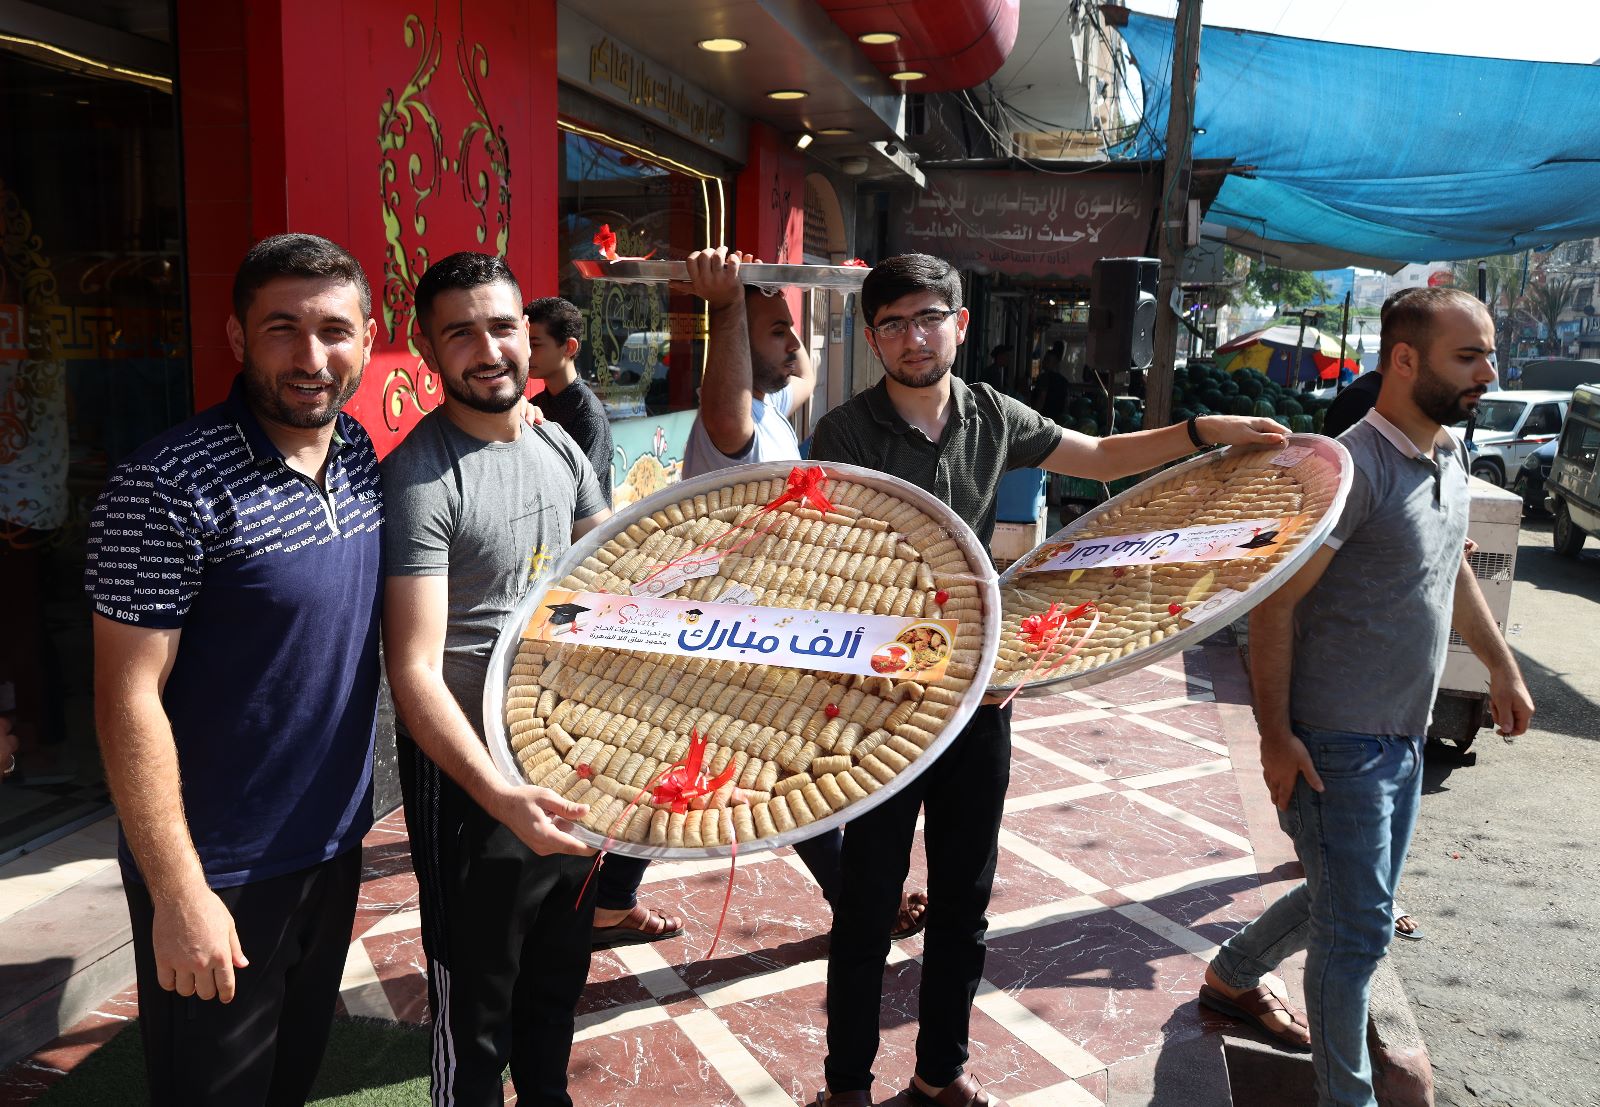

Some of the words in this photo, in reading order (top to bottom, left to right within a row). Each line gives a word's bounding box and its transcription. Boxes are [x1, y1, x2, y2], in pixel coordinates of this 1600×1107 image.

[206, 440, 223, 449] HUGO
[182, 452, 199, 464] HUGO
[212, 453, 230, 462] HUGO
[142, 465, 159, 473] BOSS
[161, 457, 178, 471] BOSS
[219, 466, 236, 476] HUGO
[243, 470, 260, 482] BOSS
[136, 480, 153, 488] BOSS
[157, 476, 178, 487] HUGO
[249, 485, 266, 497] BOSS
[358, 490, 376, 501] BOSS
[153, 491, 171, 502] HUGO
[173, 499, 192, 507] BOSS
[273, 500, 288, 511] HUGO
[288, 492, 304, 502] BOSS
[240, 506, 256, 516] HUGO
[256, 500, 271, 510] BOSS
[168, 511, 187, 523] BOSS
[278, 513, 295, 523] HUGO
[243, 522, 260, 532] HUGO
[261, 515, 275, 525] BOSS
[245, 535, 264, 545] HUGO
[265, 527, 282, 537] BOSS
[282, 528, 297, 539] HUGO
[297, 521, 312, 531] BOSS
[226, 536, 242, 547] BOSS
[266, 542, 282, 552] BOSS
[284, 544, 301, 553] HUGO
[301, 535, 316, 546] BOSS
[97, 602, 113, 615] HUGO
[116, 610, 139, 621] BOSS
[677, 619, 780, 654] مبارك
[789, 626, 866, 659] ألف
